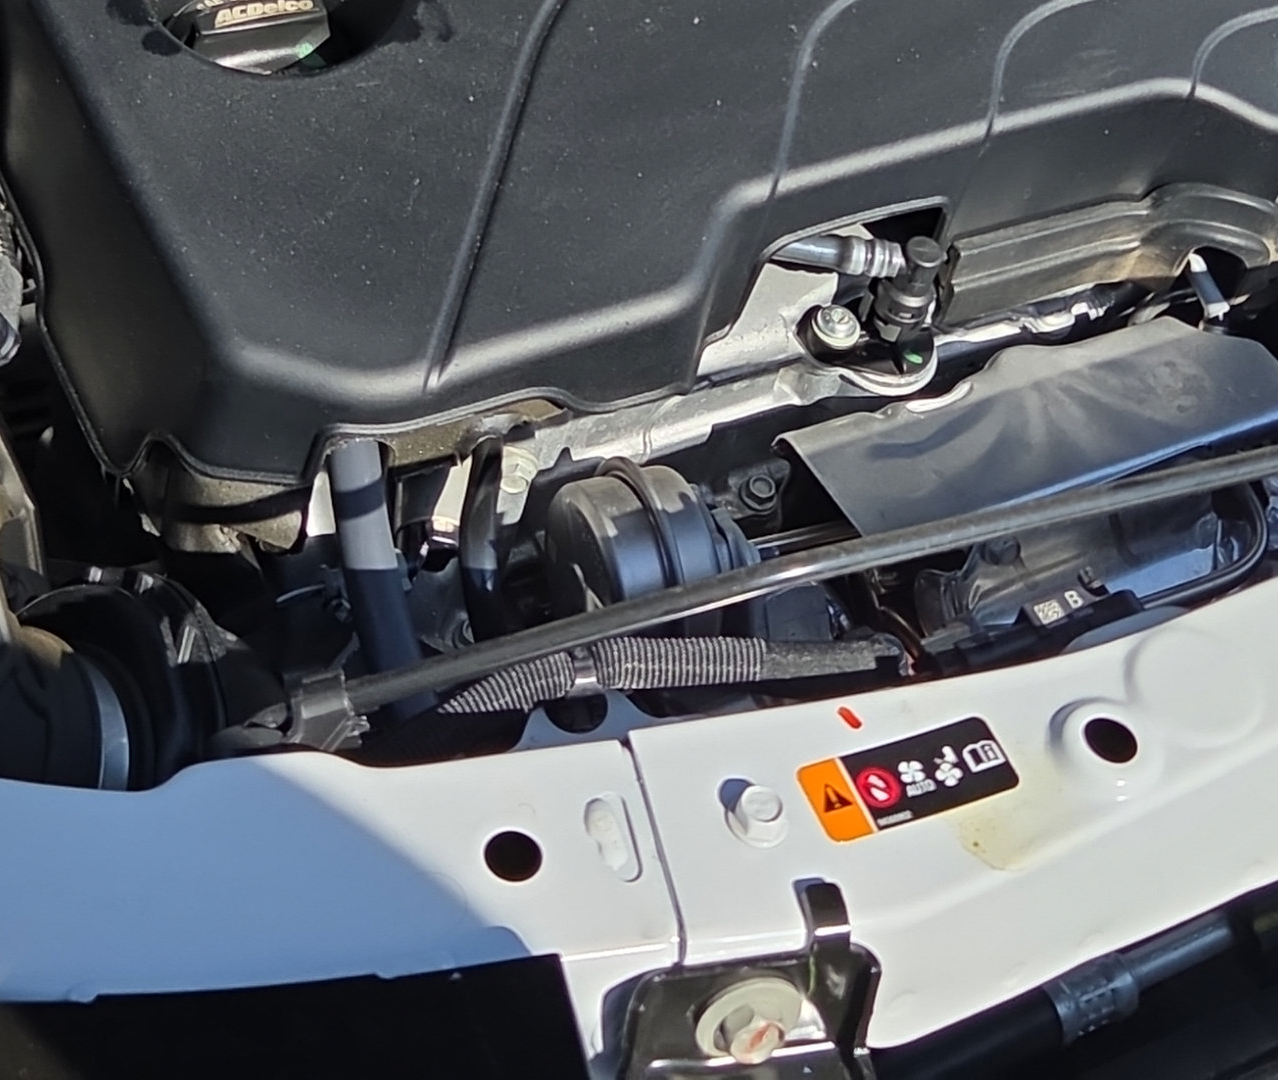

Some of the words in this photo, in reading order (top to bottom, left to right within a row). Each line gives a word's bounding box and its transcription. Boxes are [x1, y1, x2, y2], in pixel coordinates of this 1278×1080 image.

[214, 0, 314, 27] ACDelco
[1064, 590, 1084, 609] B
[905, 778, 938, 798] AUTO
